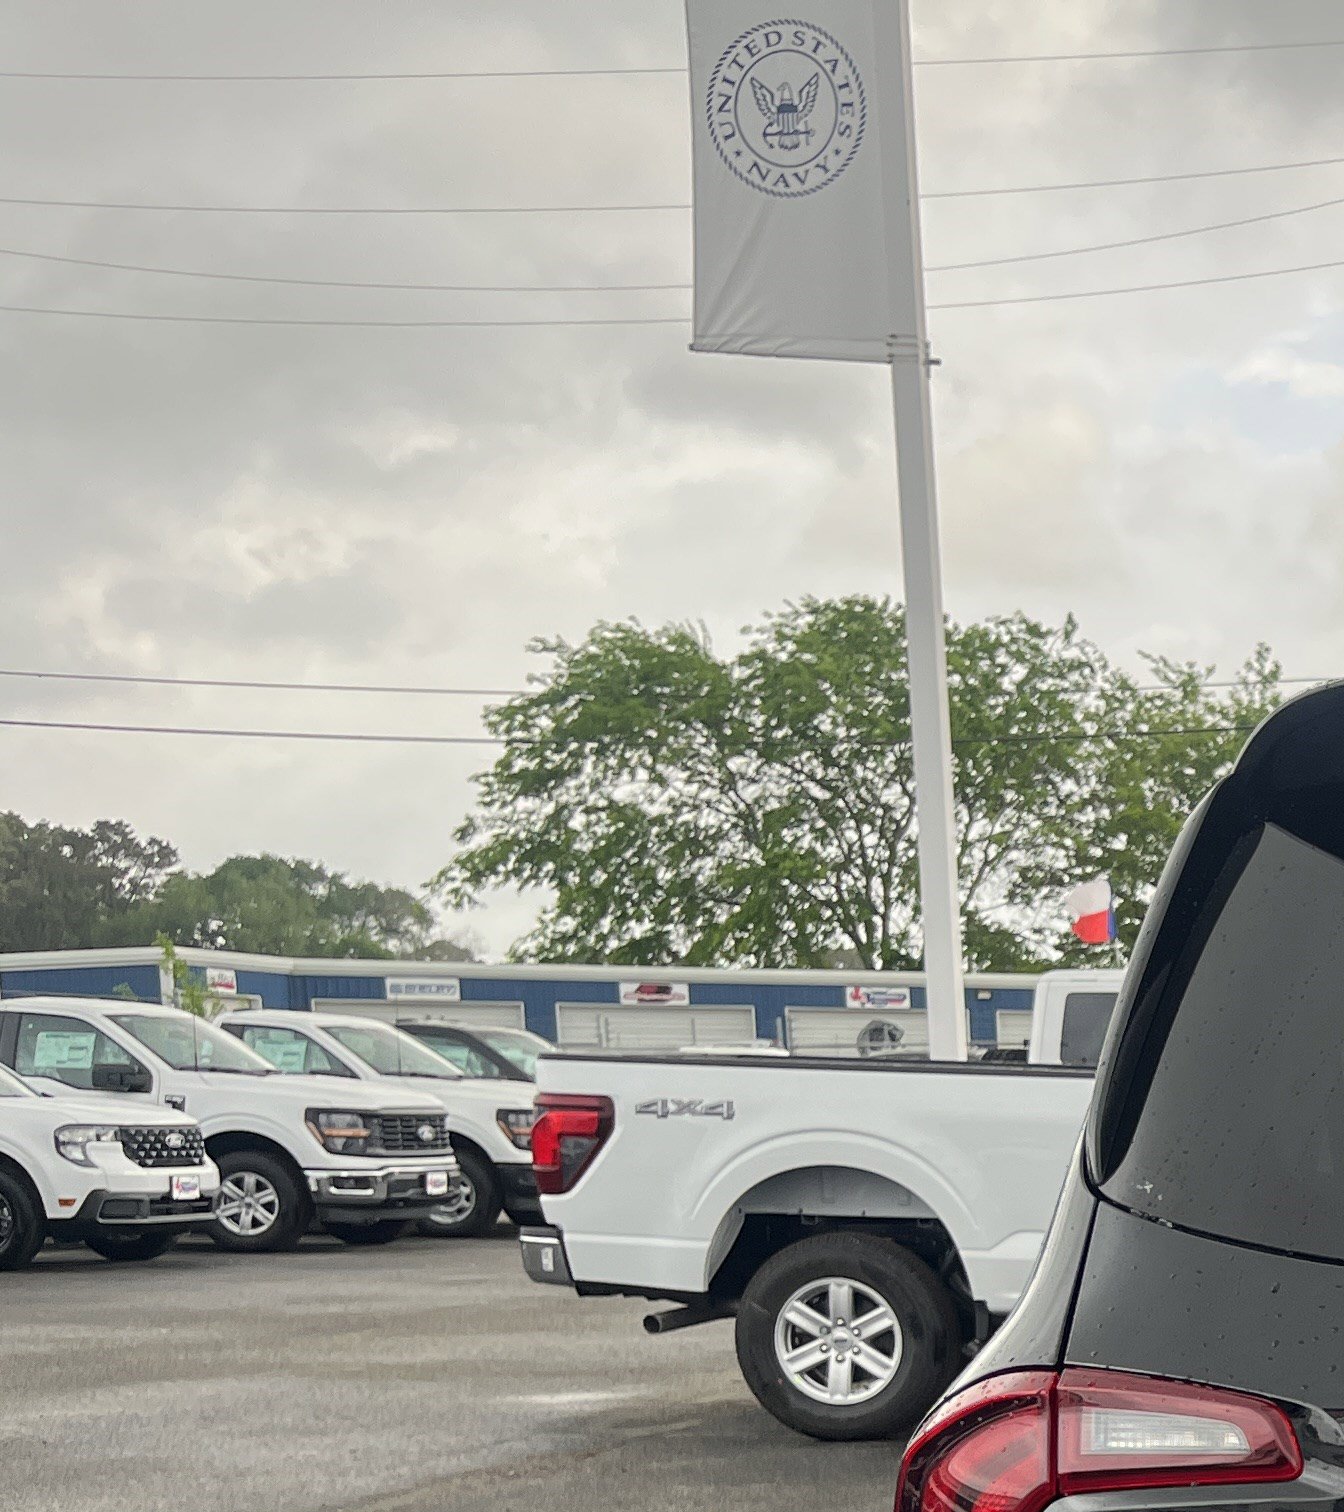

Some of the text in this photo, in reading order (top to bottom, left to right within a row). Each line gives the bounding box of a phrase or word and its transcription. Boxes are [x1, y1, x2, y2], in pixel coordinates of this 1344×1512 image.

[717, 29, 856, 142] UNITED STATES
[746, 155, 832, 188] NAVY
